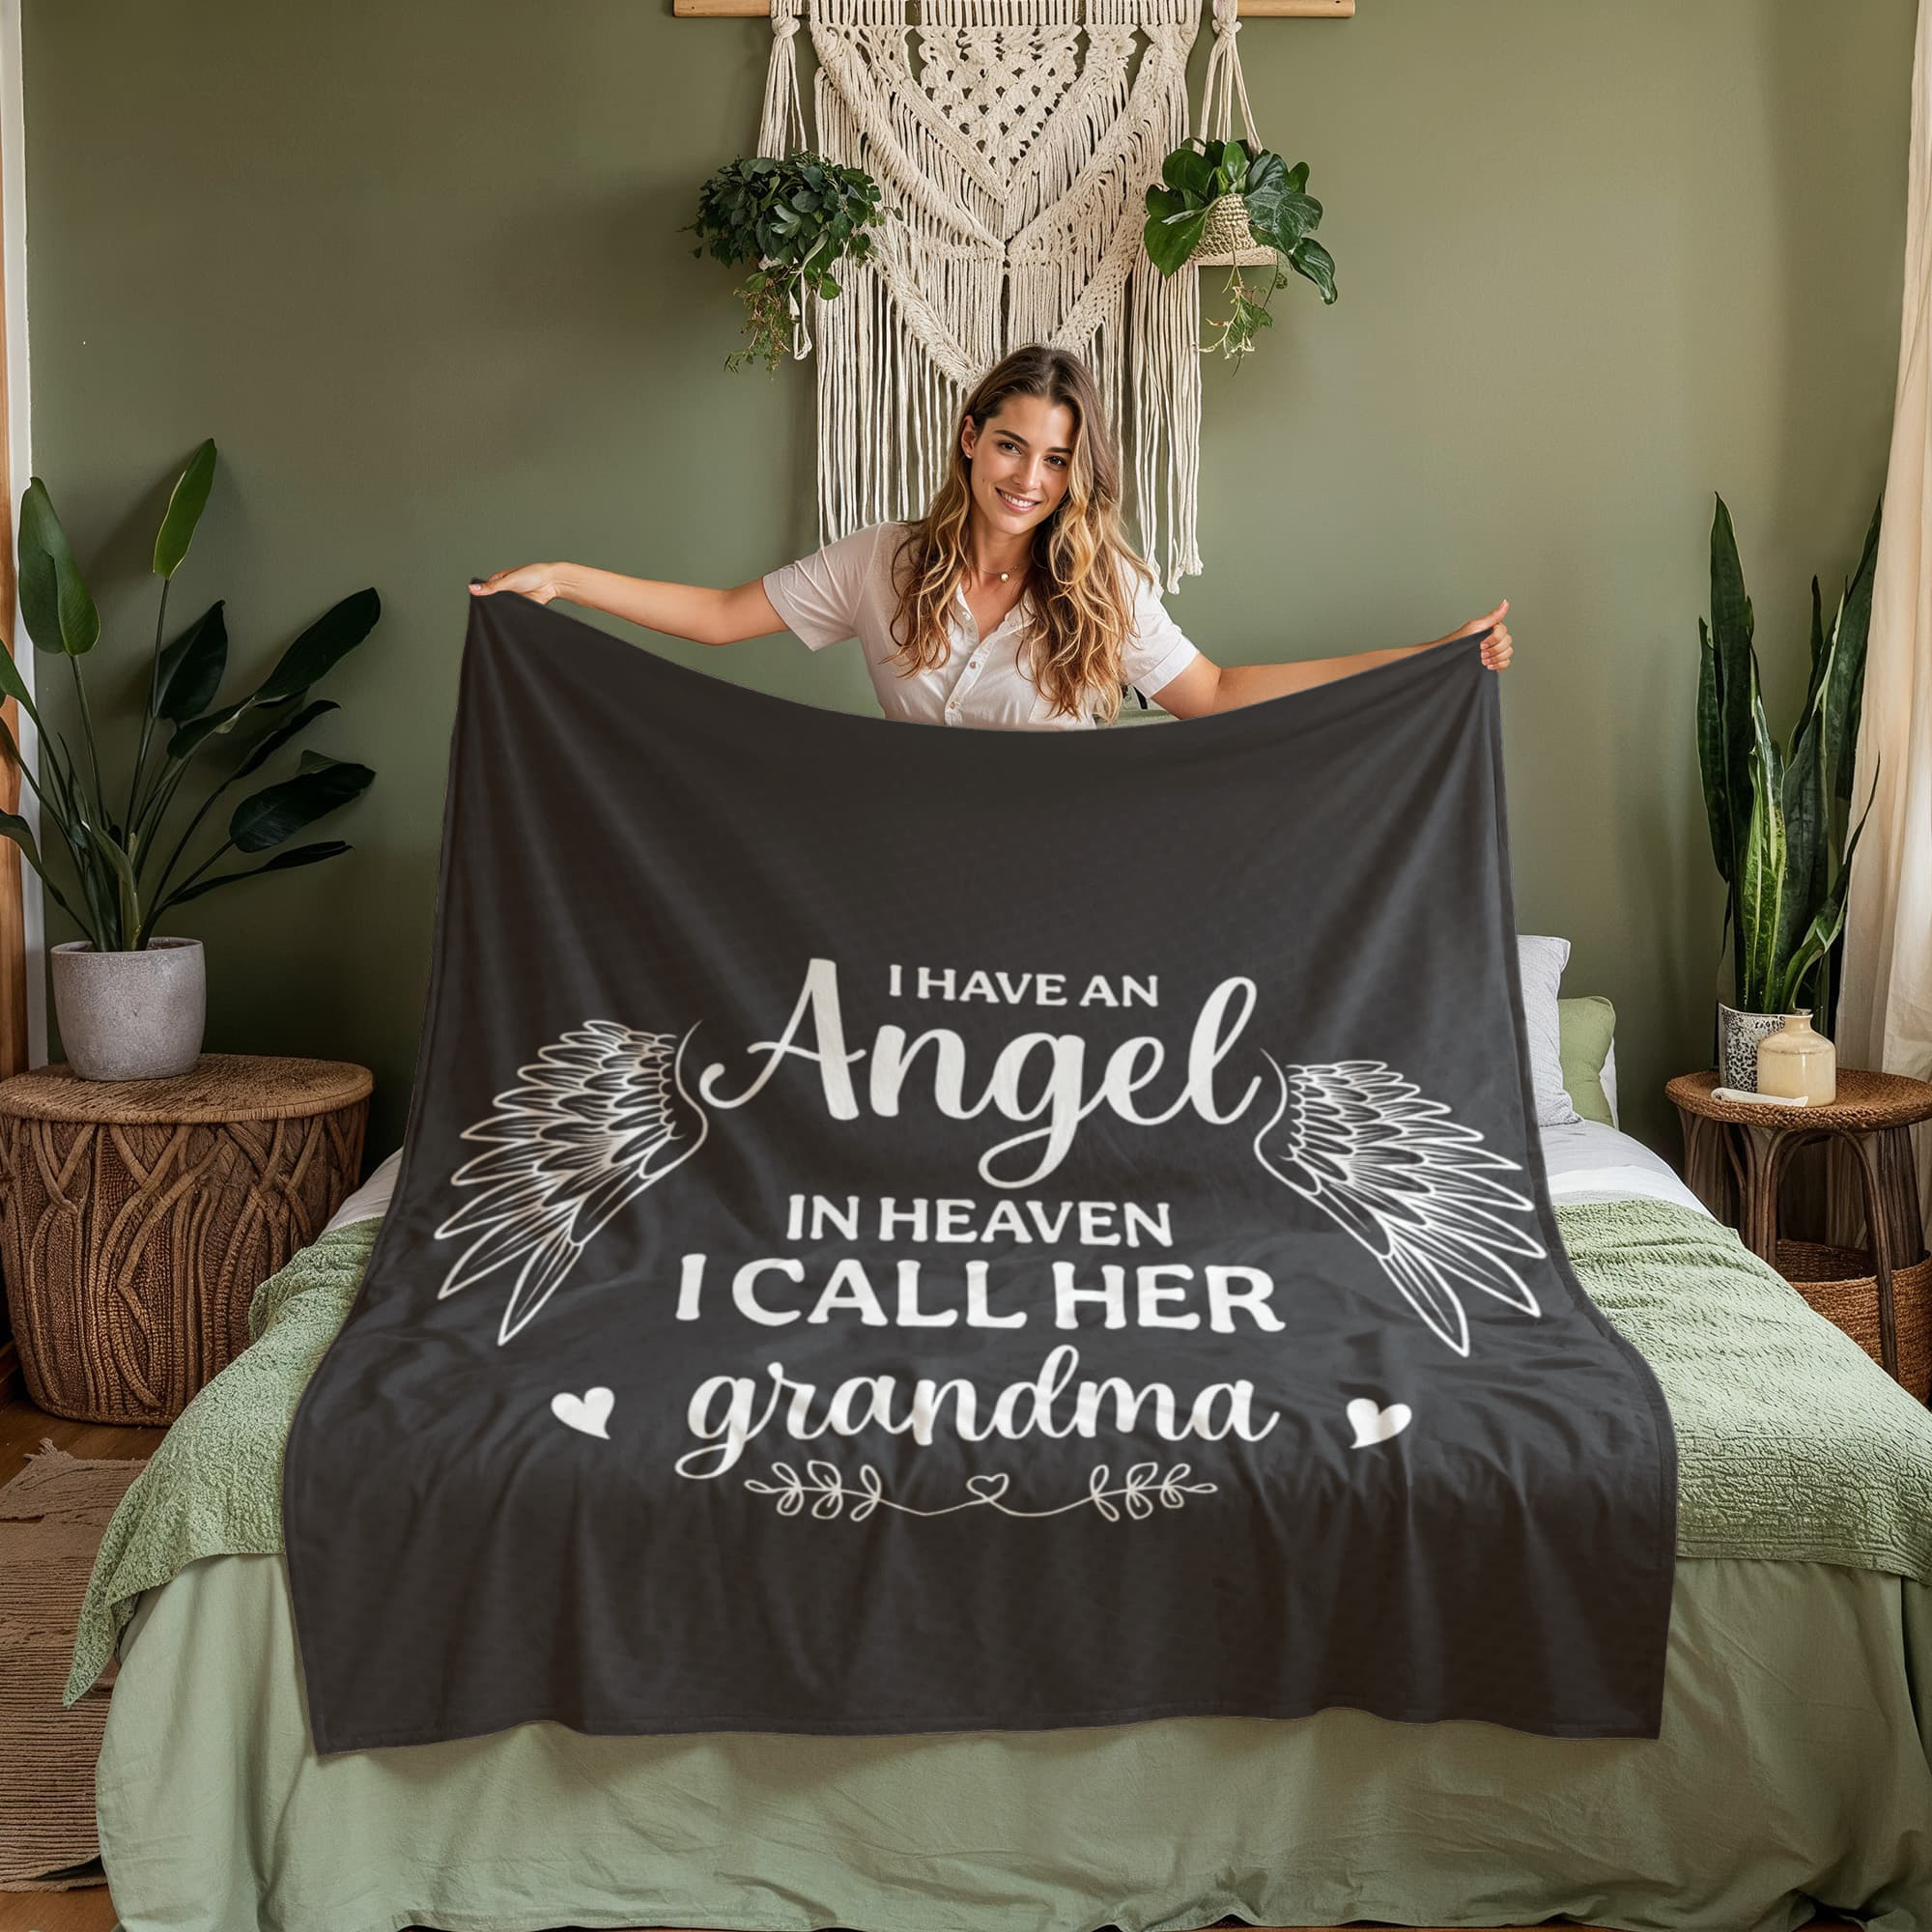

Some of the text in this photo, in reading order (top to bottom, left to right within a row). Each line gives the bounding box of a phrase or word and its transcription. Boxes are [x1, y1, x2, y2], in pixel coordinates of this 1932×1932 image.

[889, 964, 1159, 1008] I HAVE AN
[698, 958, 1263, 1189] Angel
[785, 1193, 1174, 1248] IN HEAVEN
[675, 1253, 1287, 1334] I CALL HER
[674, 1344, 1281, 1480] grandma
